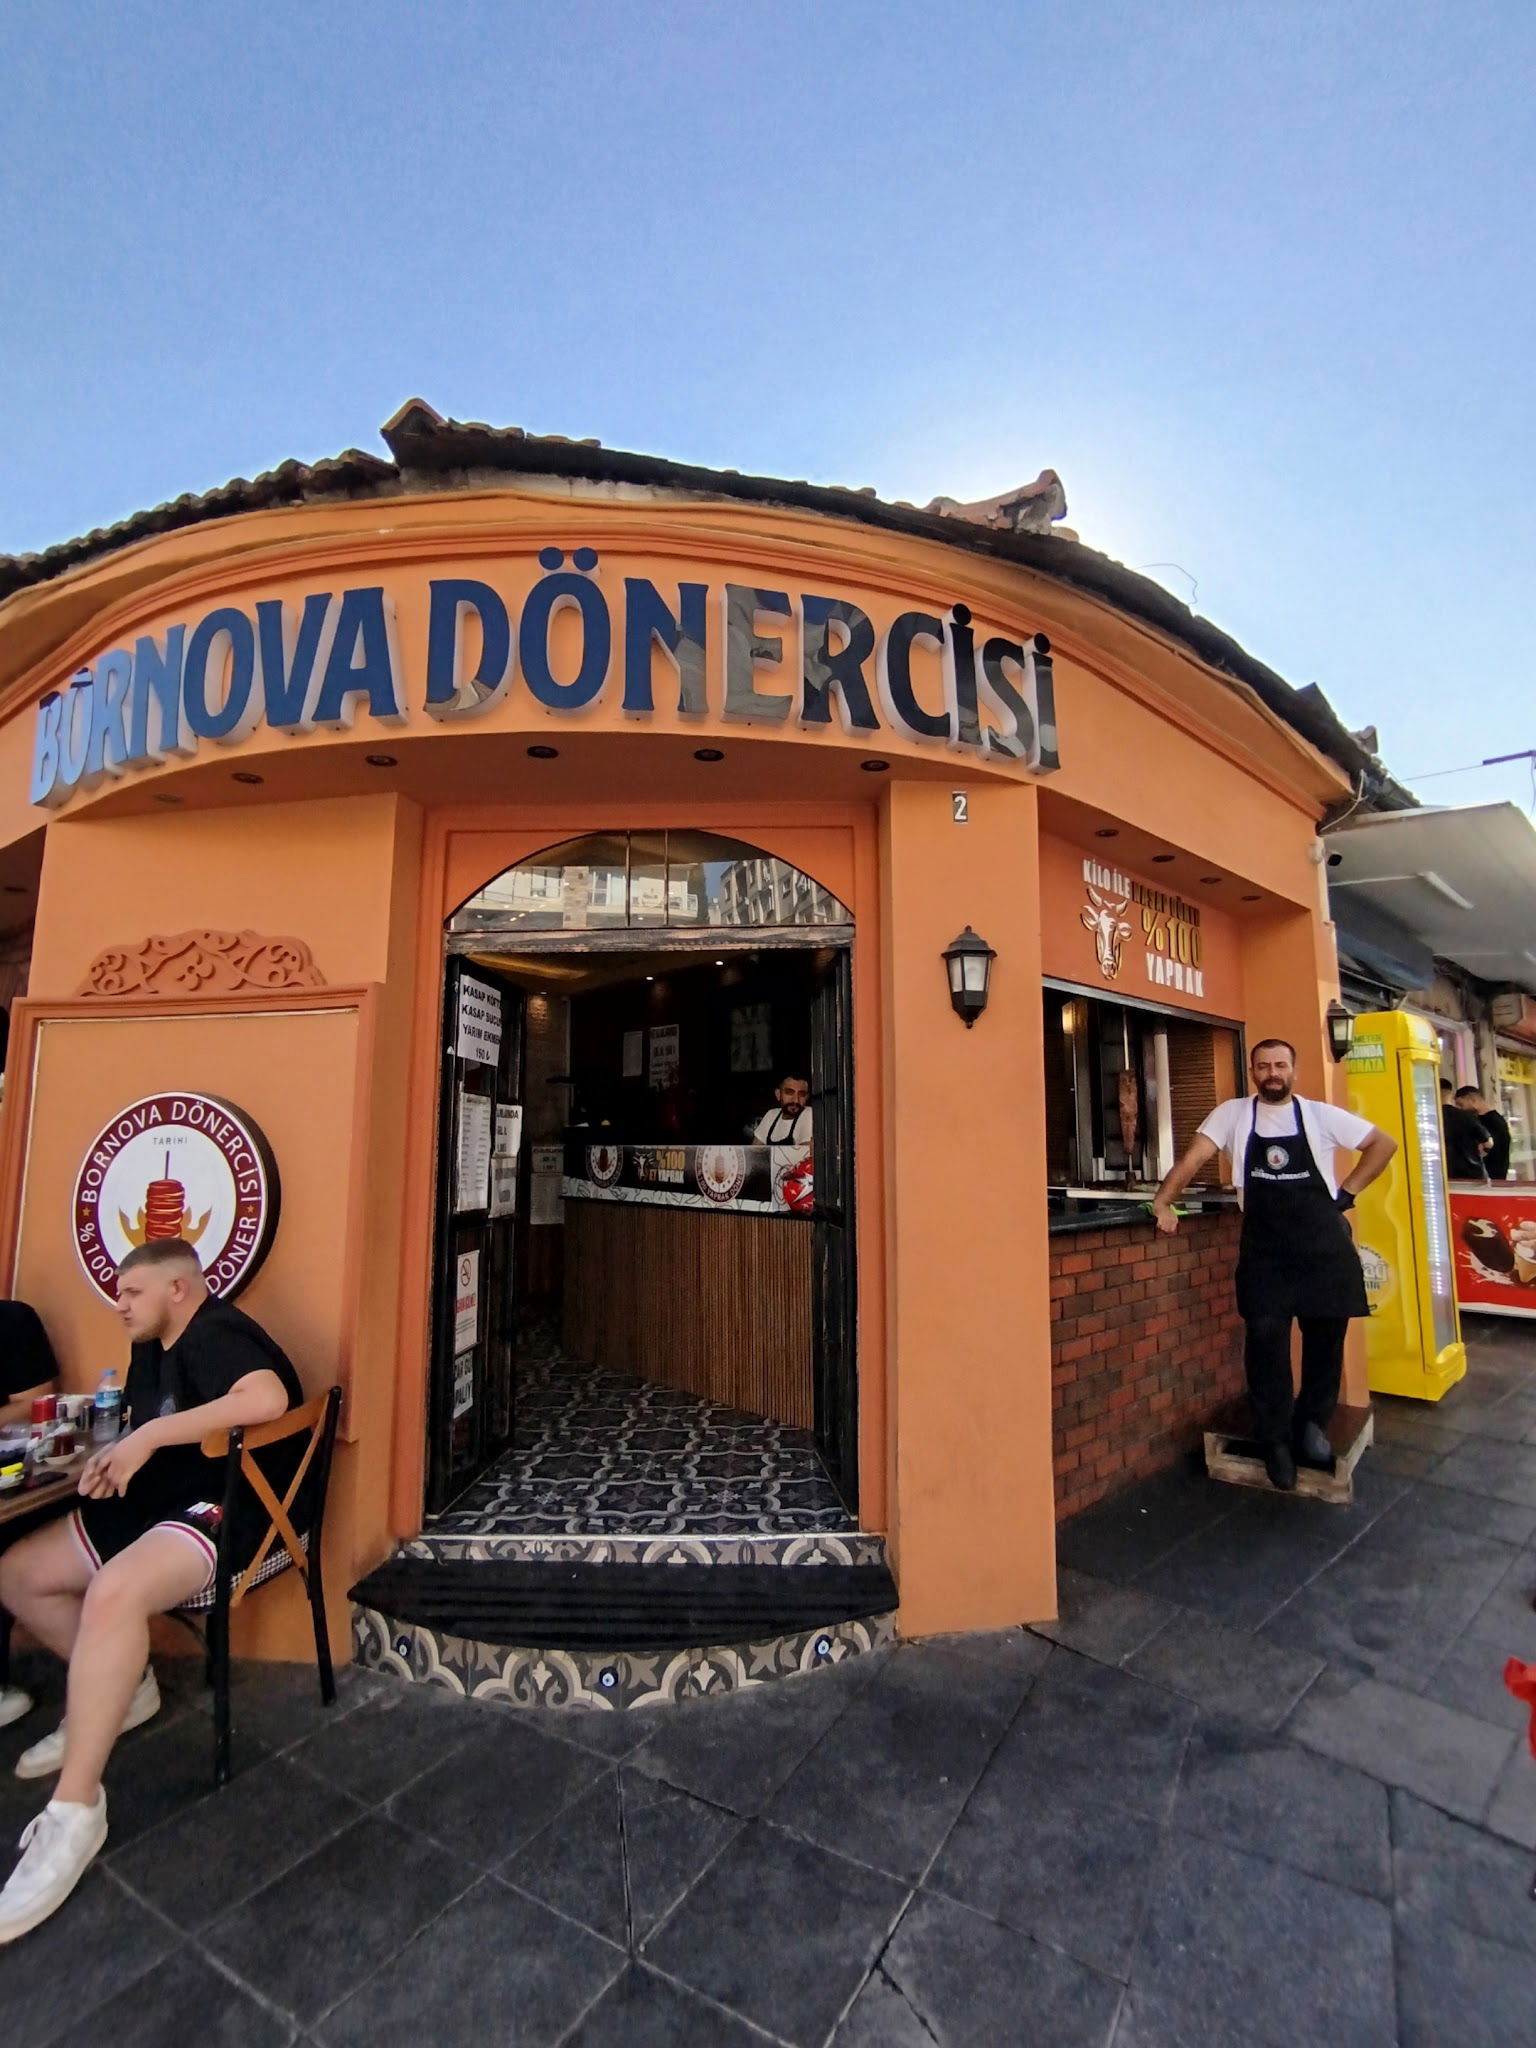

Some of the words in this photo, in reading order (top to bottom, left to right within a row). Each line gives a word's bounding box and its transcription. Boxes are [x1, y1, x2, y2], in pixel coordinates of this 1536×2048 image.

[31, 586, 401, 808] BORNOVA
[423, 547, 1061, 772] DÖNERCİSİ
[953, 795, 968, 820] 2
[1083, 858, 1111, 892] KİLO
[1113, 867, 1131, 899] İLE
[1141, 908, 1201, 969] %100
[463, 984, 485, 1002] KASAP
[1146, 952, 1204, 998] YAPRAK
[461, 1003, 484, 1021] KASAP
[81, 1104, 163, 1204] BORNOVA
[171, 1101, 262, 1202] DÖNERCİSİ
[152, 1135, 189, 1146] TARİHİ
[656, 1149, 686, 1170] %100
[205, 1215, 258, 1295] DÖNER
